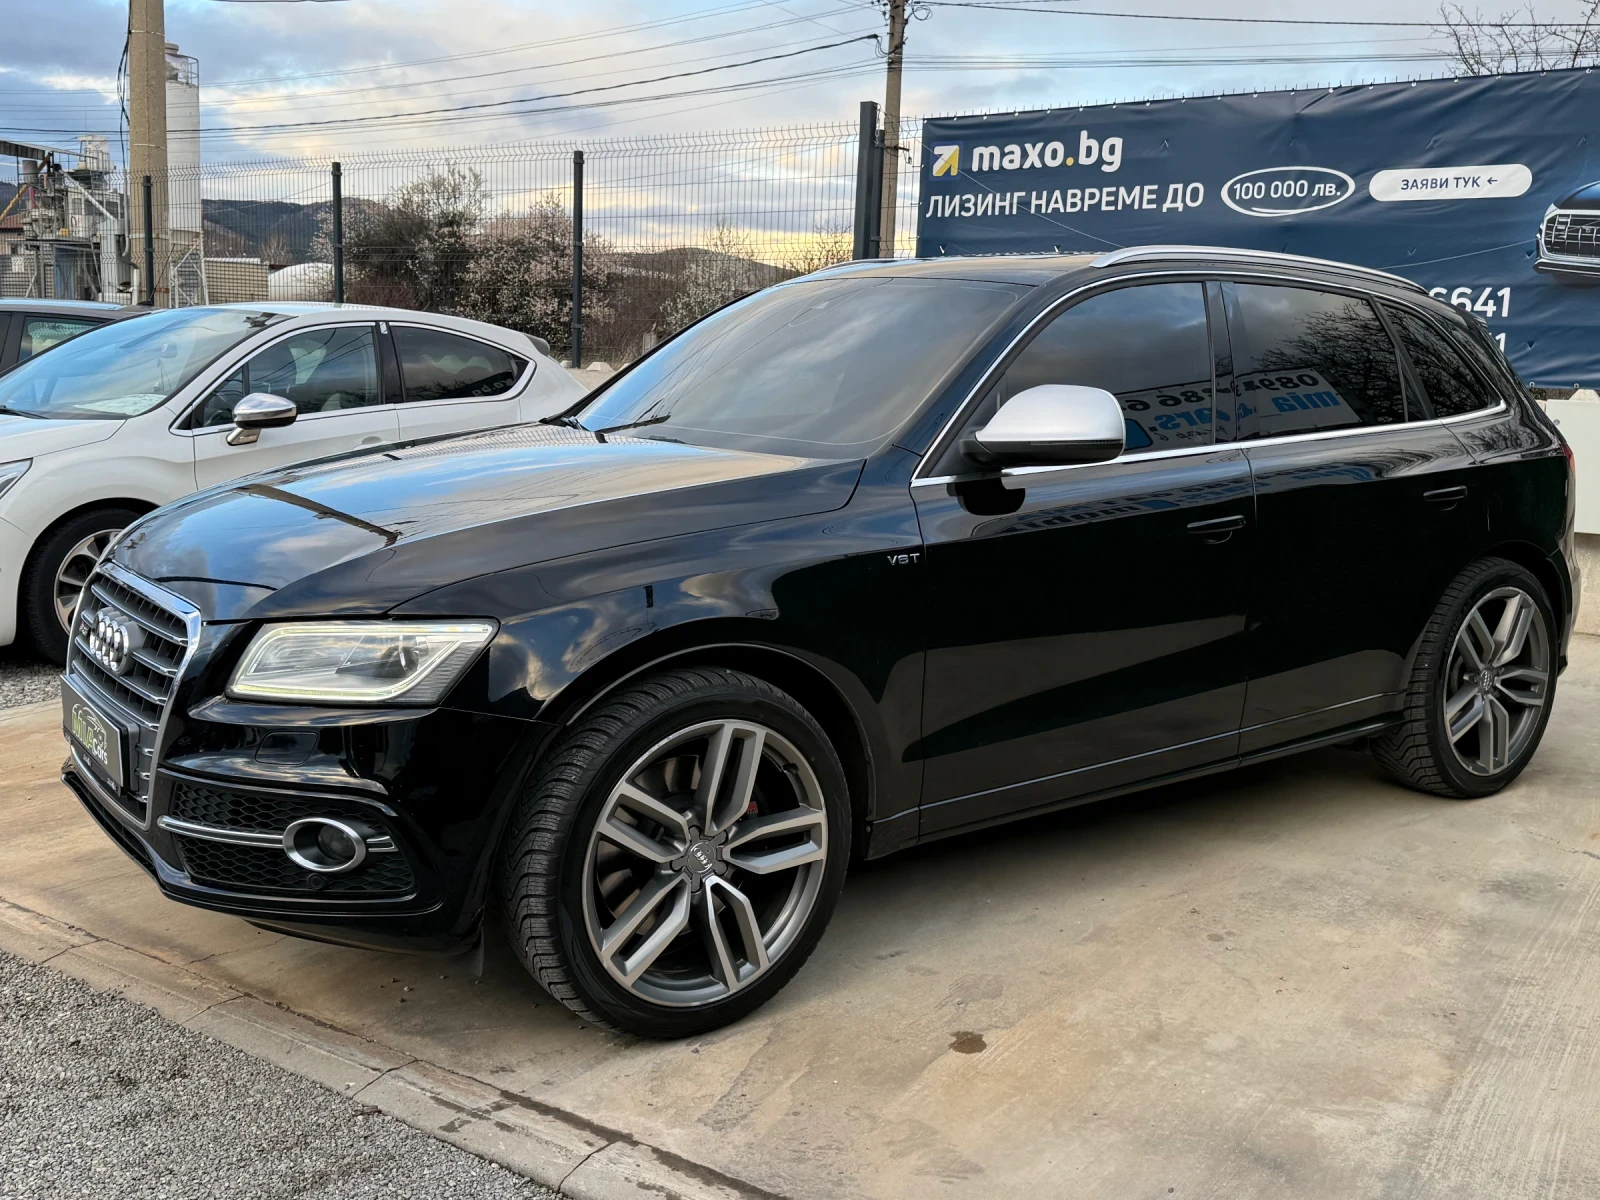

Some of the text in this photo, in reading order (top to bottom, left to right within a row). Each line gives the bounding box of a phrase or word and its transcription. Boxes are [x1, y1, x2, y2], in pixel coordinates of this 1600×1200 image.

[971, 130, 1123, 172] maxo.bg
[925, 180, 1341, 218] ЛИЗИНГ НАВРЕМЕ ДО 100 000 лв.
[1400, 176, 1481, 191] ЗАЯВИ ТУК
